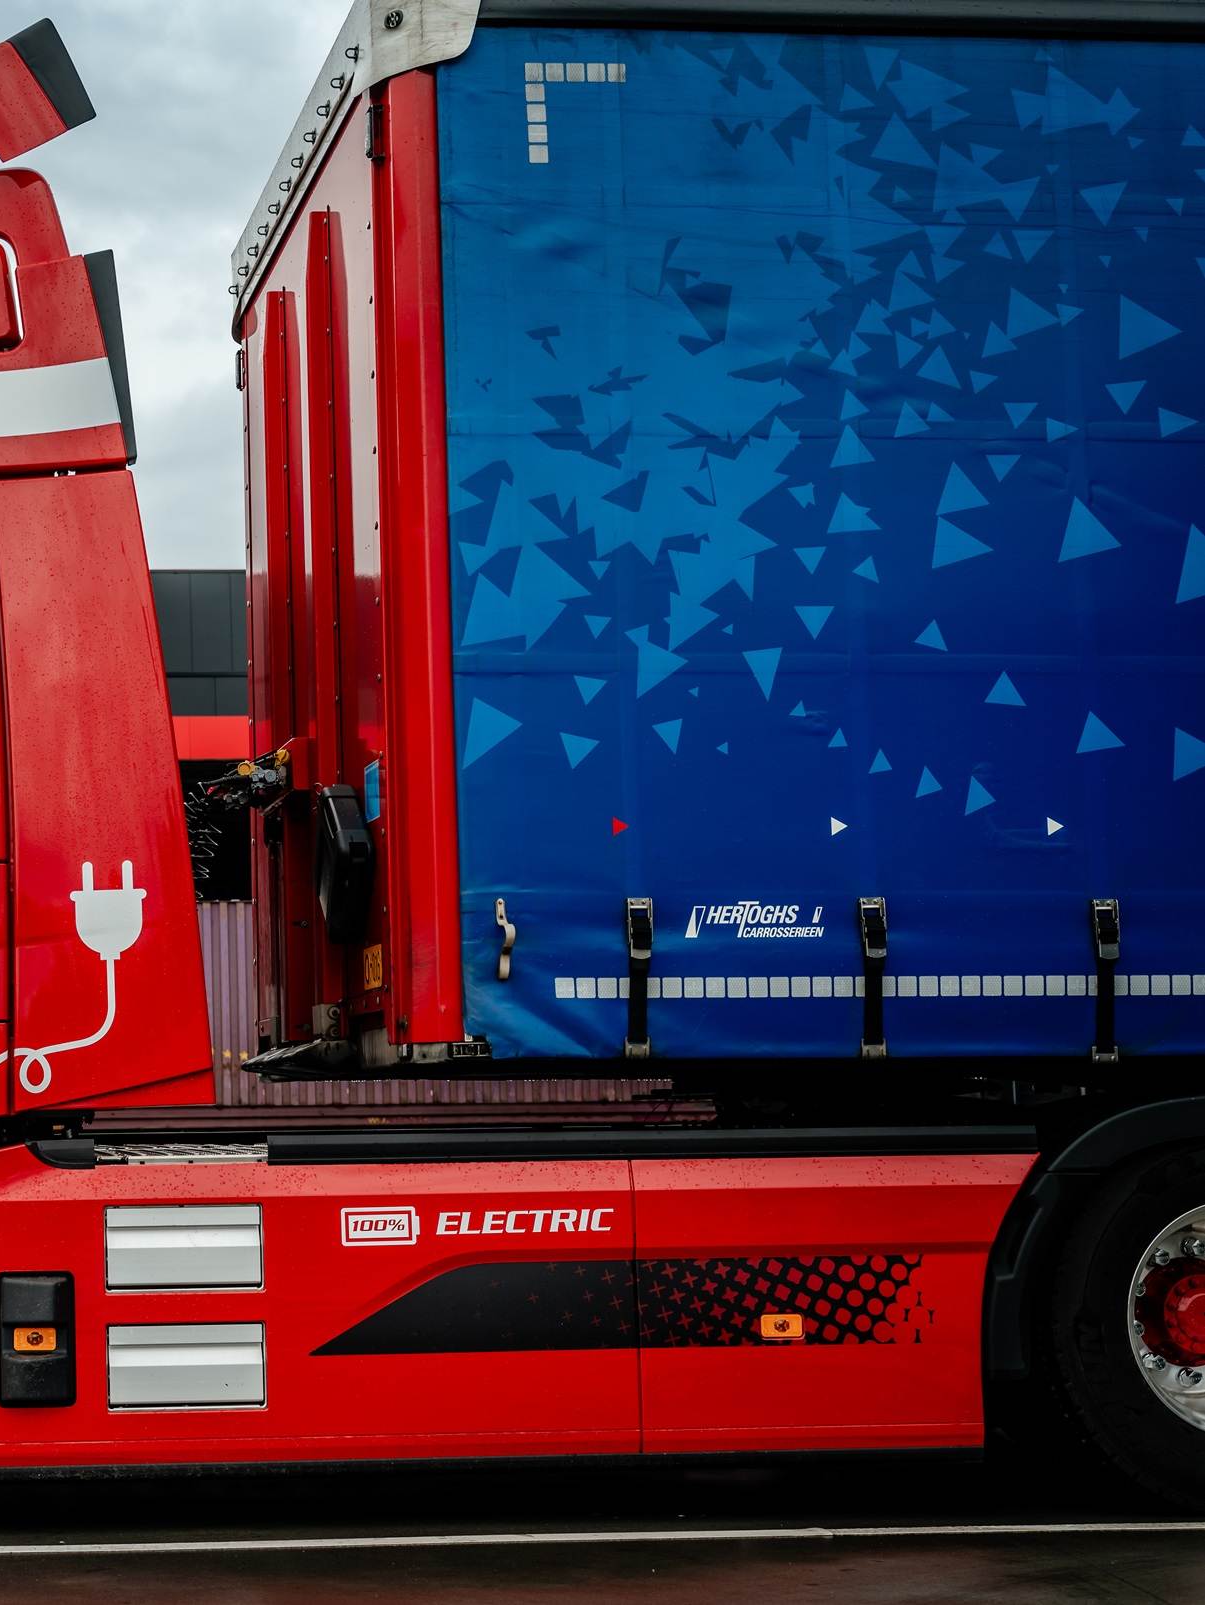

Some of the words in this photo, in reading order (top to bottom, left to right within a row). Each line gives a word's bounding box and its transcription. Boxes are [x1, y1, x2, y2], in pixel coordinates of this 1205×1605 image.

[706, 901, 799, 935] HERTOGHS
[742, 927, 824, 938] CARROSSERIEEN
[352, 1218, 405, 1232] 100%
[436, 1208, 614, 1235] ELECTRIC
